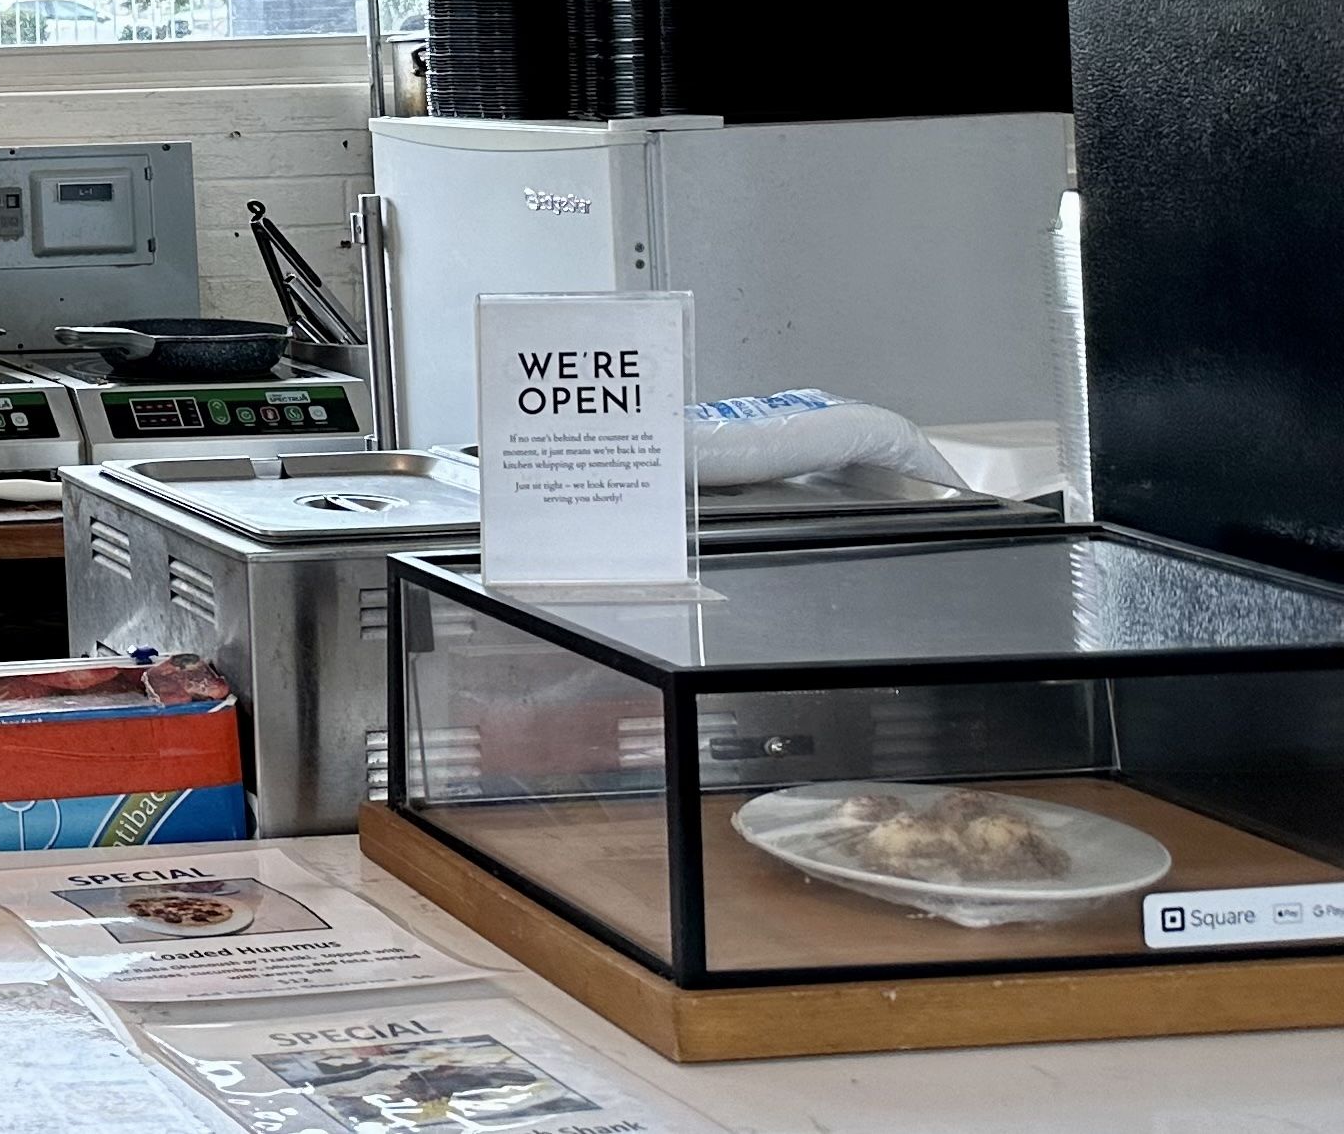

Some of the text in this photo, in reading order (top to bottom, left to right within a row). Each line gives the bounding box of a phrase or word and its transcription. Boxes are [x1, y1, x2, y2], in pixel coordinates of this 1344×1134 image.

[518, 384, 641, 414] OPEN!
[553, 433, 581, 442] behind
[641, 432, 653, 440] the
[617, 446, 636, 454] back
[607, 479, 639, 488] forward
[67, 867, 215, 887] SPECIAL
[1191, 909, 1256, 929] Square
[150, 939, 342, 962] Loaded Hummus
[267, 1019, 442, 1047] SPECIAL
